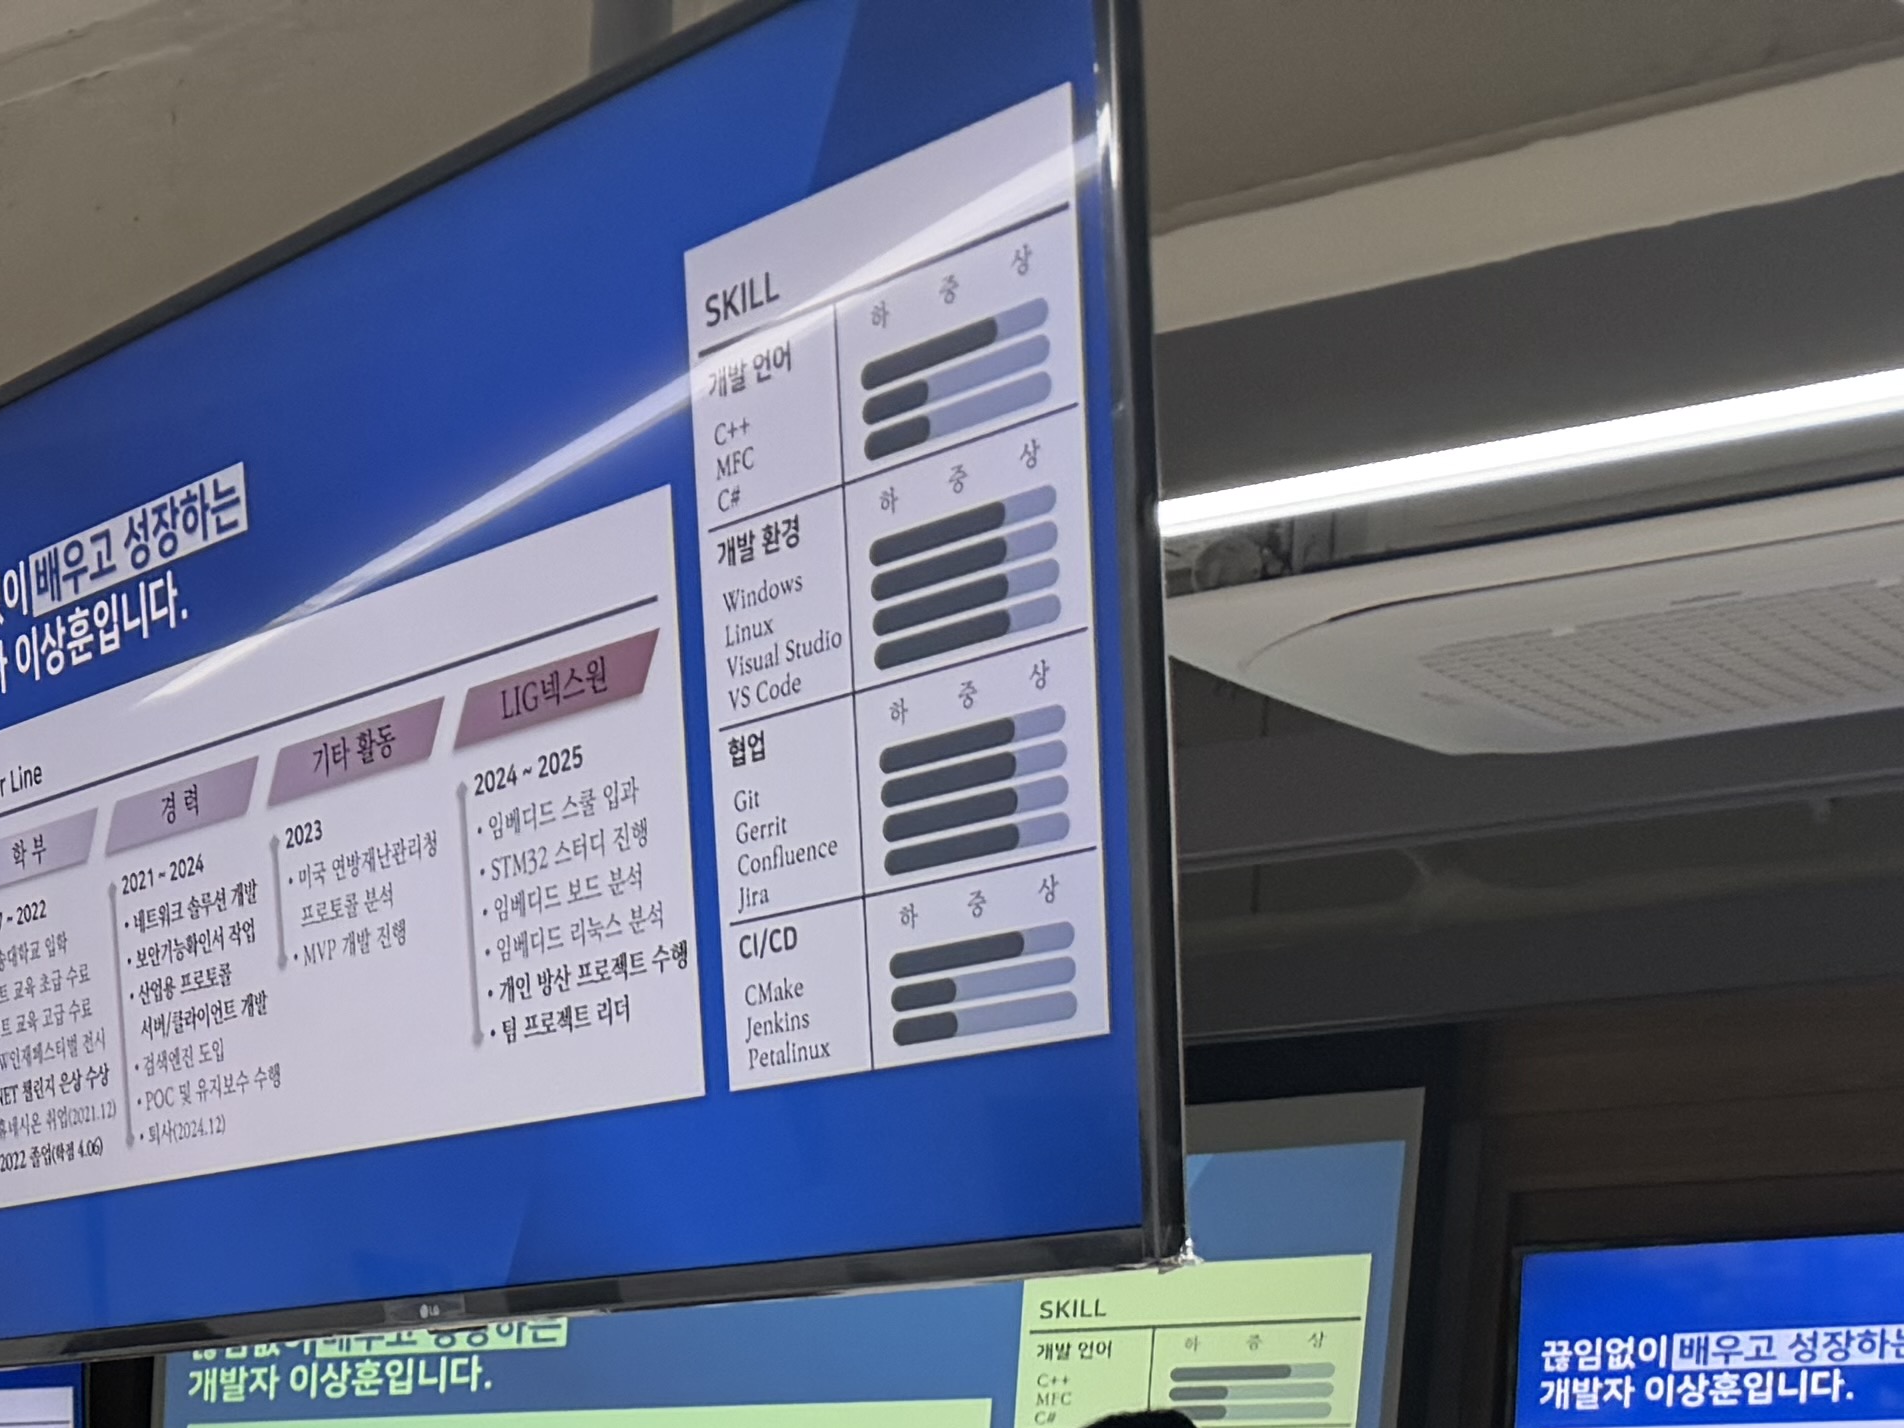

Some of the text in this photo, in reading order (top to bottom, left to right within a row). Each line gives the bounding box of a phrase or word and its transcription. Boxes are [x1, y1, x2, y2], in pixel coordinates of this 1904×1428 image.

[705, 271, 780, 328] SKILL
[709, 341, 792, 398] 개발 언어
[714, 417, 751, 447] C++
[716, 446, 755, 481] MFC
[717, 485, 741, 513] C#
[34, 478, 241, 602] 배우고 성장하는
[717, 514, 801, 567] 개발 환경
[723, 575, 804, 613] Windows
[15, 570, 188, 681] 이상훈입니다.
[725, 618, 775, 648] Linux
[726, 629, 843, 678] Visual Studio
[501, 655, 608, 720] LIG넥스원
[728, 672, 802, 711] VS Code
[313, 724, 396, 778] 기타 활동
[728, 730, 766, 768] 협업
[10, 765, 43, 794] Line
[474, 763, 518, 797] 2024
[538, 745, 583, 779] 2025
[488, 775, 640, 841] 임베디드 스쿨 입과
[733, 789, 761, 813] Git
[285, 819, 323, 850] 2023
[491, 817, 648, 882] STM32 스터디 진행
[736, 815, 788, 845] Gerrit
[121, 868, 154, 896] 2021
[169, 853, 205, 882] 2024
[298, 829, 437, 889] 미국 연방재난관리청
[738, 840, 839, 877] Confluence
[16, 899, 47, 926] 2022
[133, 878, 258, 934] 네트워크 솔루션 개발
[301, 881, 394, 928] 프로토콜 분석
[494, 862, 643, 924] 임베디드 보드 분석
[738, 887, 770, 915] Jira
[44, 931, 68, 959] 입학
[135, 917, 256, 969] 보안기능확인서 작업
[303, 918, 406, 967] MVP 개발 진행
[496, 900, 664, 964] 임베디드 리눅스 분석
[739, 926, 798, 960] CI/CD
[13, 975, 36, 1001] 교육
[39, 968, 63, 994] 초급
[65, 963, 91, 988] 수료
[138, 962, 232, 1006] 산업용 프로토콜
[500, 939, 688, 1004] 개인 방산 프로젝트 수행
[745, 977, 805, 1007] CMake
[15, 1009, 39, 1034] 교육
[42, 1003, 66, 1028] 고급
[68, 997, 93, 1023] 수료
[141, 989, 268, 1041] 서버/클라이언트 개발
[502, 993, 630, 1045] 팀 프로젝트 리더
[745, 1010, 811, 1044] Jenkins
[83, 1026, 106, 1055] 전시
[143, 1037, 225, 1078] 검색엔진 도입
[748, 1040, 831, 1071] Petalinux
[22, 1073, 56, 1103] 챌린지
[58, 1068, 83, 1095] 은상
[85, 1062, 110, 1091] 수상
[145, 1062, 282, 1112] POC 및 유지보수 수행
[0, 1149, 27, 1173] 2022
[1040, 1299, 1106, 1319] SKILL
[1541, 1335, 1667, 1372] 끊임없이
[1679, 1335, 1777, 1366] 배우고
[189, 1354, 492, 1403] 개발자 이상훈입니다.
[1539, 1368, 1854, 1410] 개발자 이상훈입니다.
